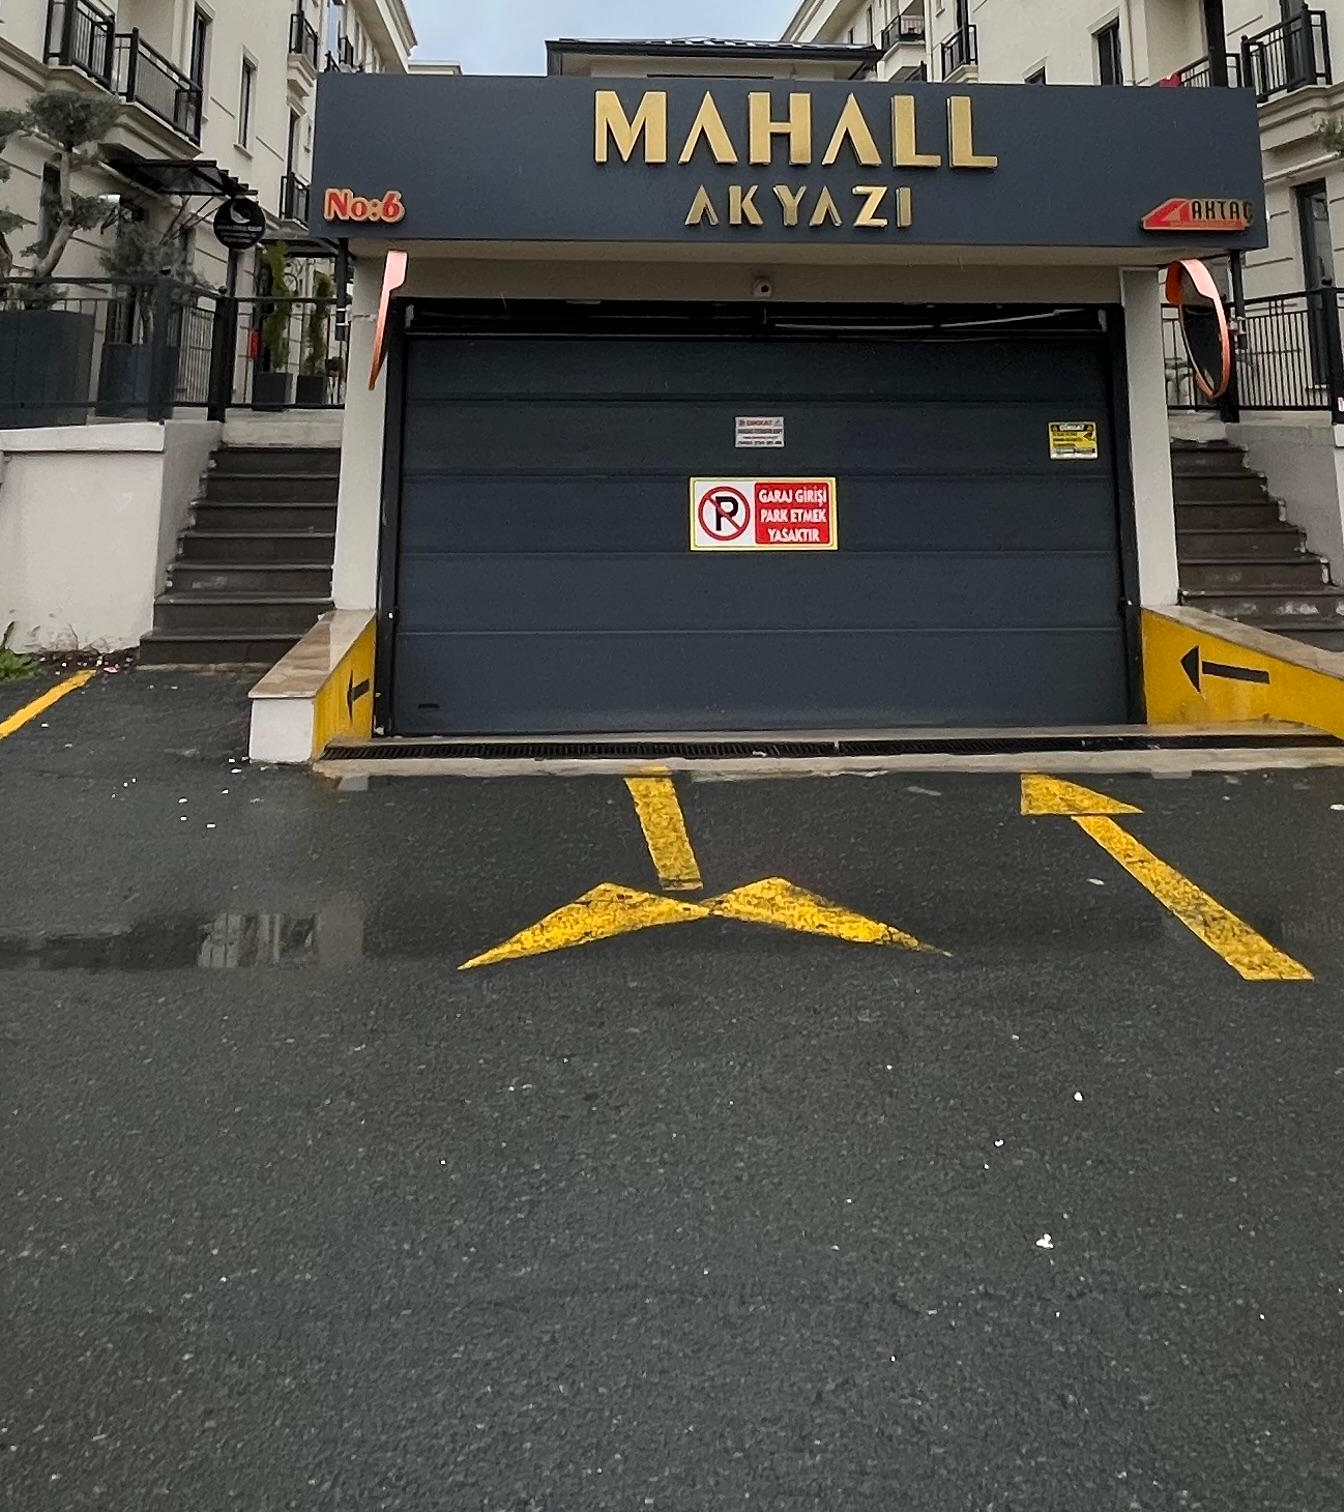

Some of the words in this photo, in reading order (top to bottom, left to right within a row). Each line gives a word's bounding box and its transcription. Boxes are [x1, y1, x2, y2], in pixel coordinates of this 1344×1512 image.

[595, 90, 998, 168] MAHALL
[324, 188, 405, 223] No:6
[684, 184, 912, 227] AKYAZI
[759, 489, 793, 504] GARAJ
[761, 509, 788, 523] PARK
[790, 509, 827, 523] ETMEK
[768, 529, 820, 543] YASAKTIR
